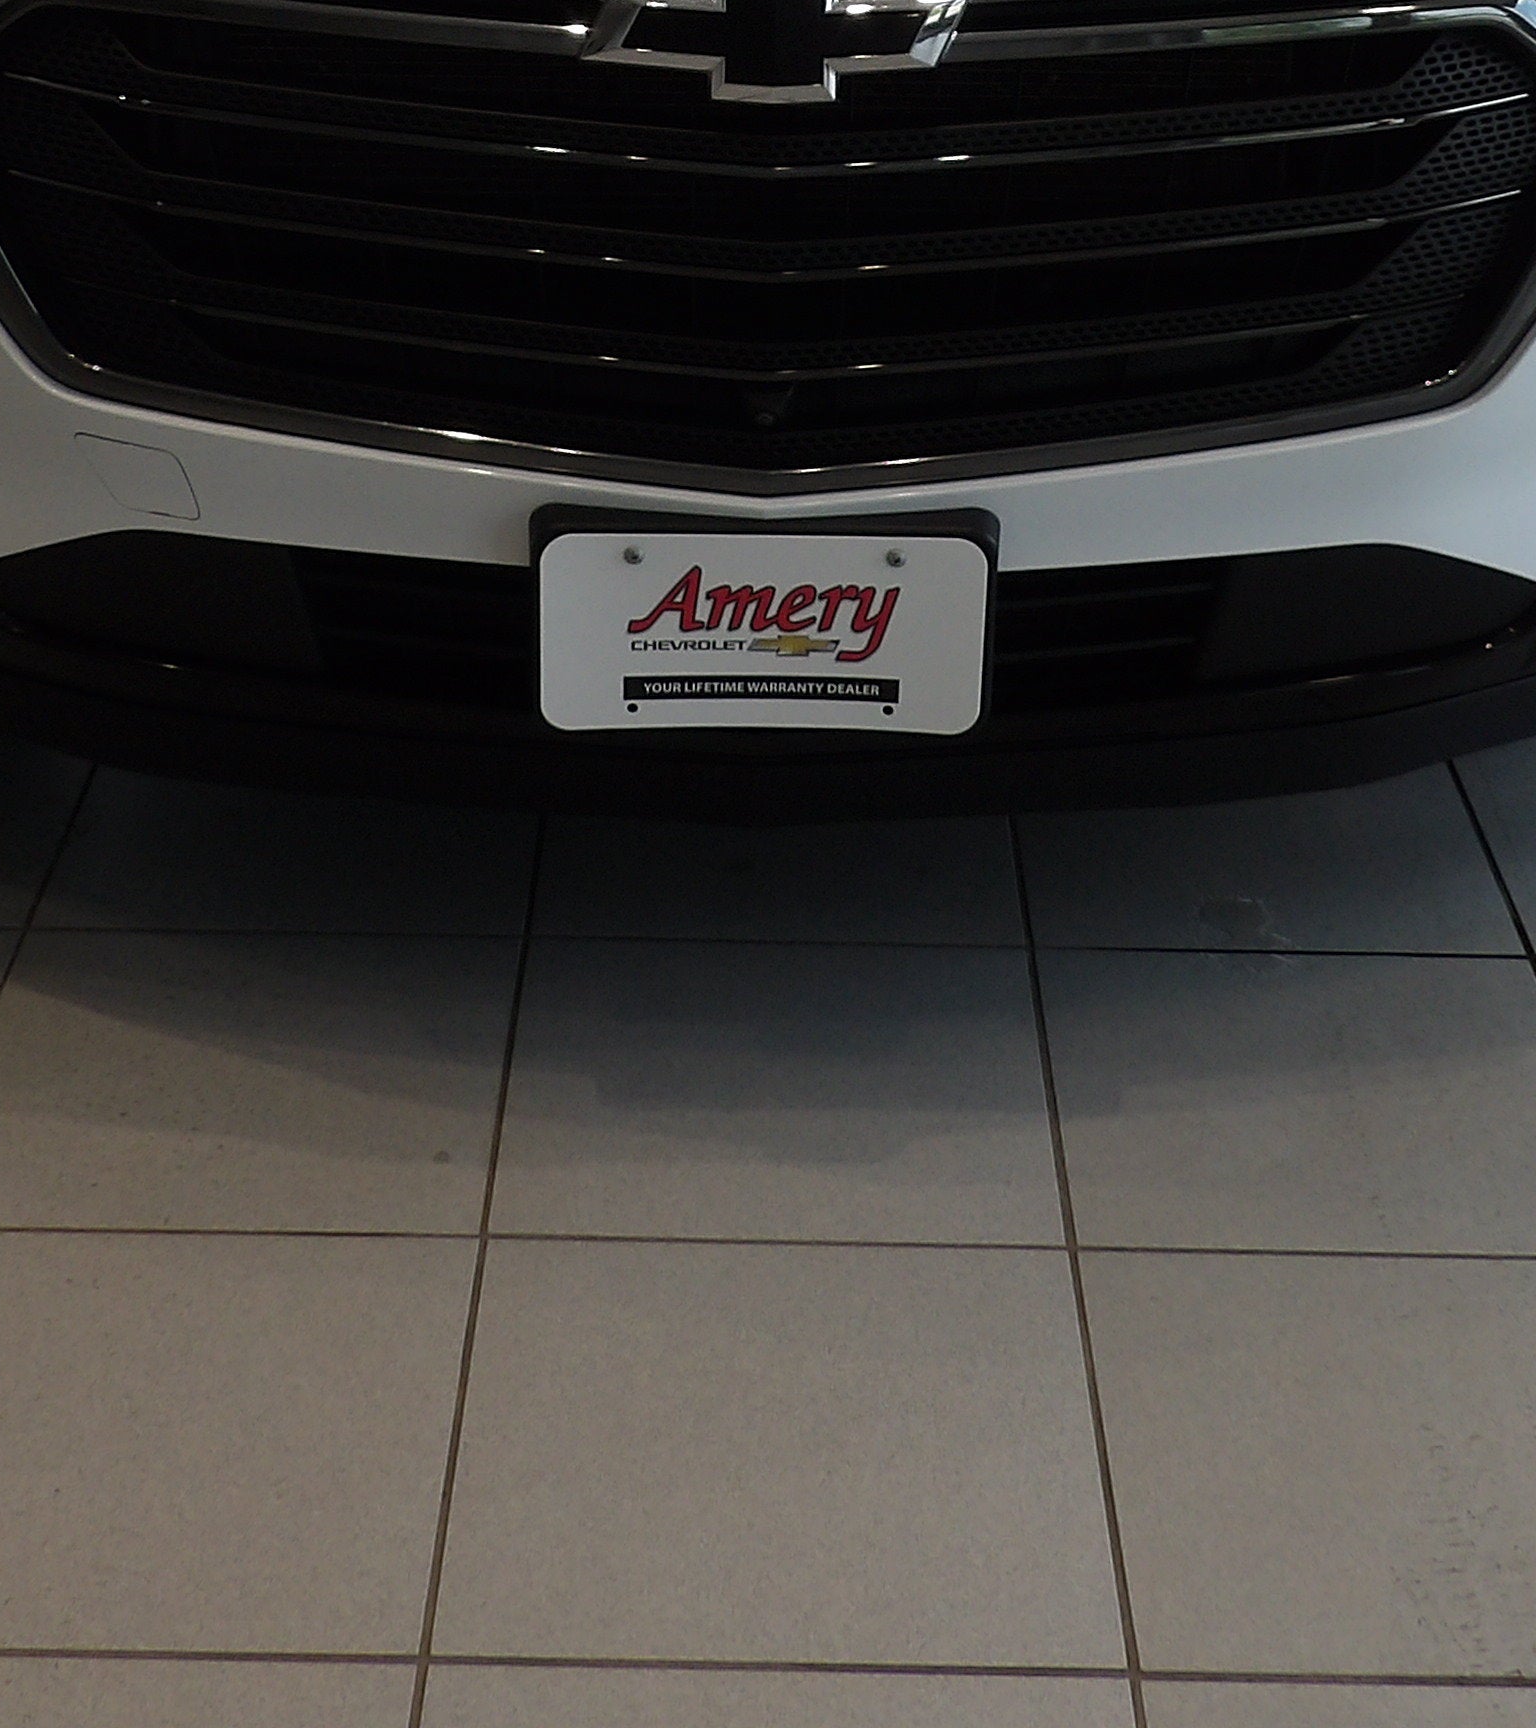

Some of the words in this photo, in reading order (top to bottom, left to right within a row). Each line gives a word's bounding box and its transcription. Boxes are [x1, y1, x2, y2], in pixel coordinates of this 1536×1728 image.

[627, 565, 900, 662] Amery
[630, 638, 747, 652] CHEVROLET
[643, 681, 682, 694] YOUR
[684, 680, 745, 694] LIFETIME
[747, 681, 825, 694] WARRANTY
[826, 683, 881, 696] DEALER
